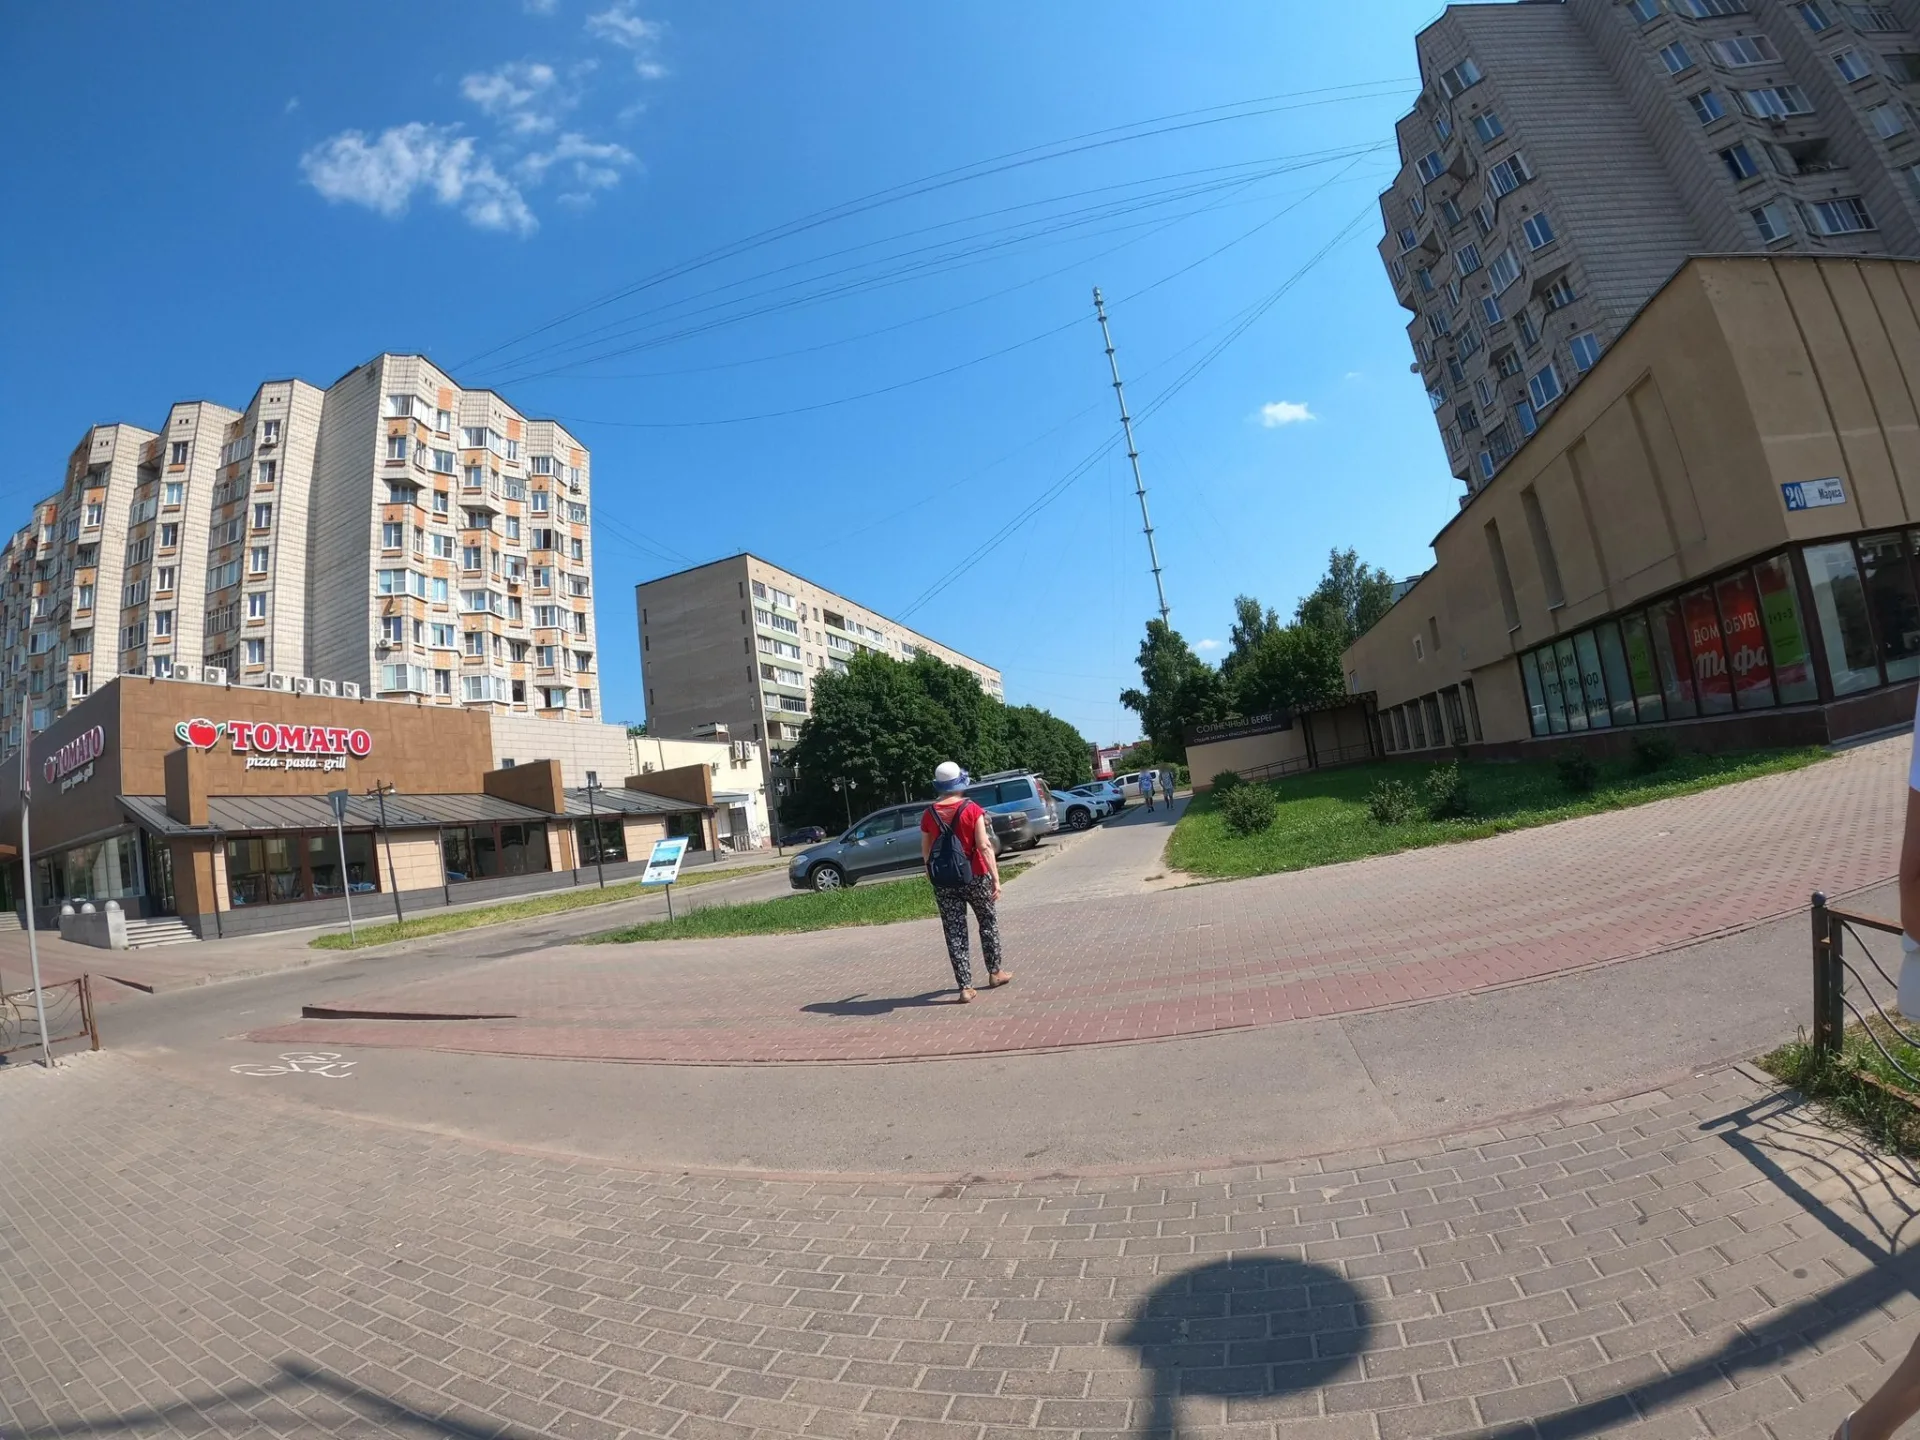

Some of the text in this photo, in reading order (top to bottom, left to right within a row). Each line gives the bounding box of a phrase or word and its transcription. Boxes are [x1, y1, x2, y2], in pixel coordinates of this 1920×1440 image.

[1785, 485, 1805, 507] 20
[1693, 623, 1720, 647] ДОМ
[1196, 713, 1273, 734] СОЛНЕЧНЫЙ БЕРЕГ
[228, 720, 371, 755] TOMATO
[56, 725, 104, 778] TOMATO
[245, 753, 346, 771] pizza pasta grill
